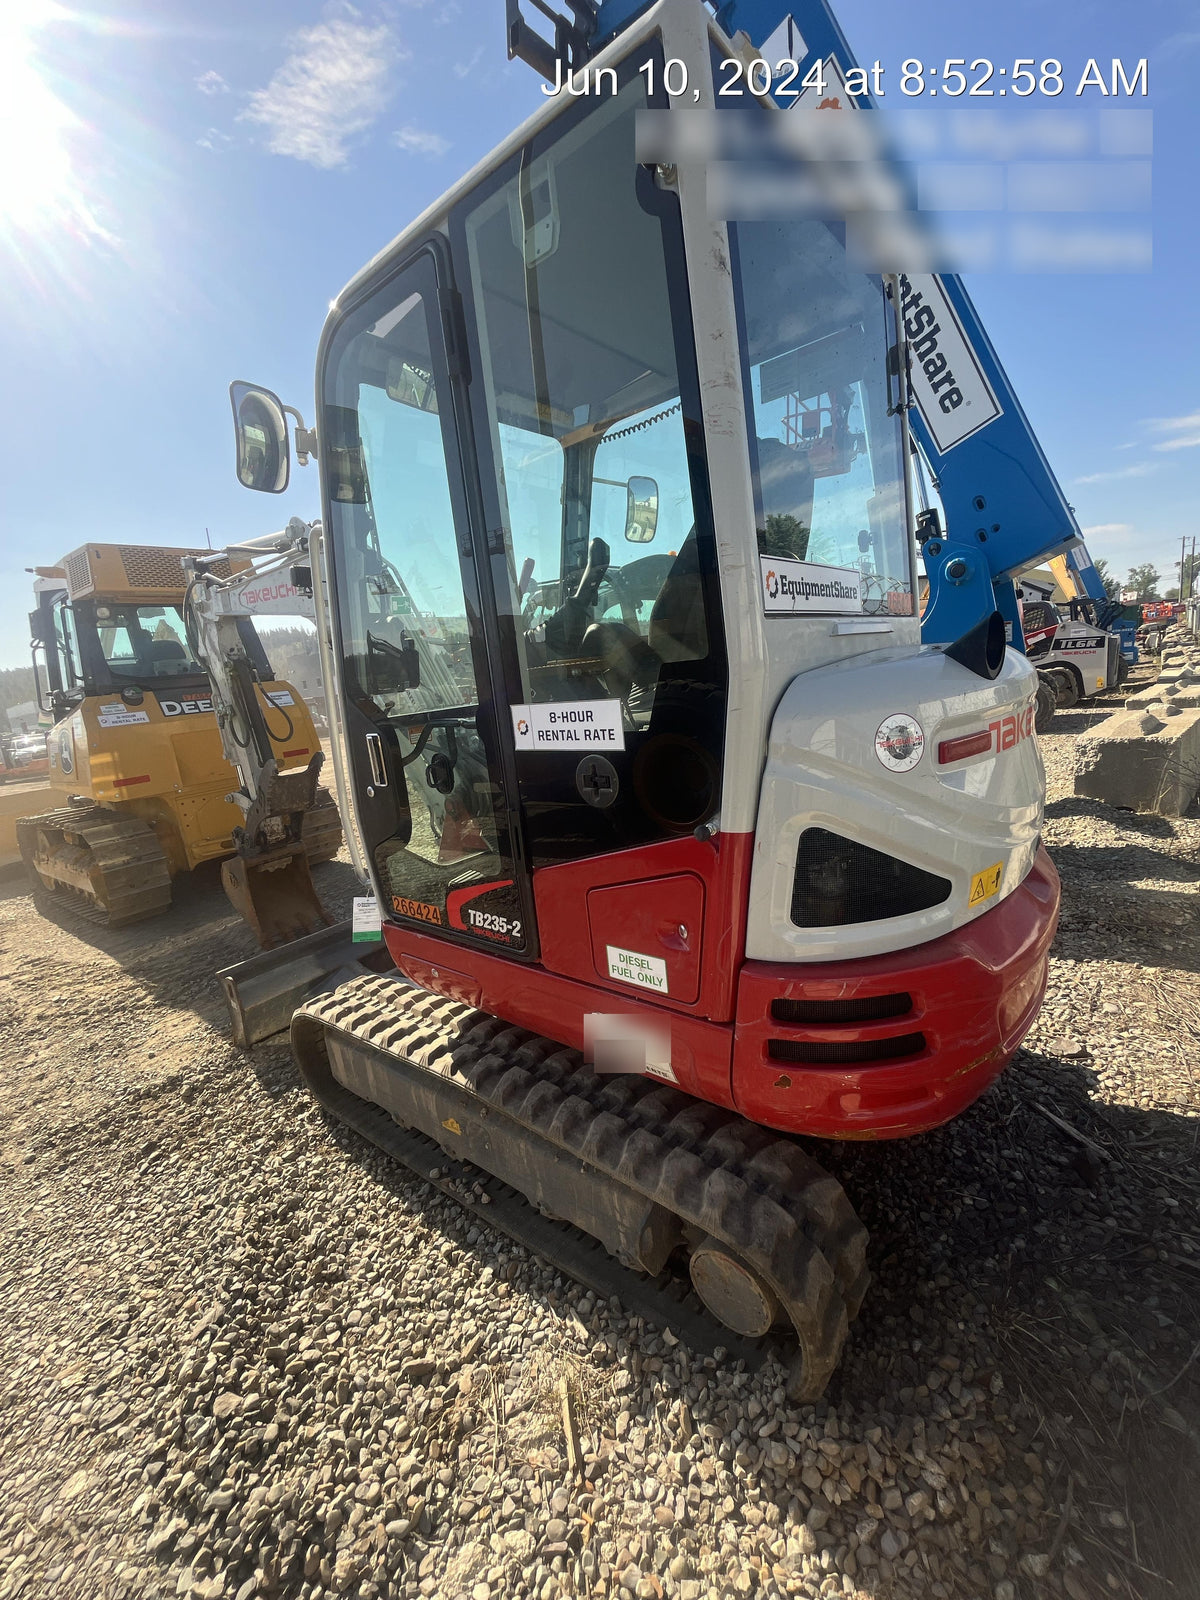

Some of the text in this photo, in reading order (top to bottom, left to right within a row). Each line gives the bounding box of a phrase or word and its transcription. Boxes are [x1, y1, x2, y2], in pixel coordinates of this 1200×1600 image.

[779, 574, 858, 601] EquipmentShare
[549, 710, 594, 723] 8-HOUR
[537, 728, 616, 741] RENTAL RATE
[393, 897, 440, 922] 266424
[468, 909, 521, 937] TB235-2
[618, 953, 654, 971] DIESEL
[611, 964, 663, 987] FUEL ONLY
